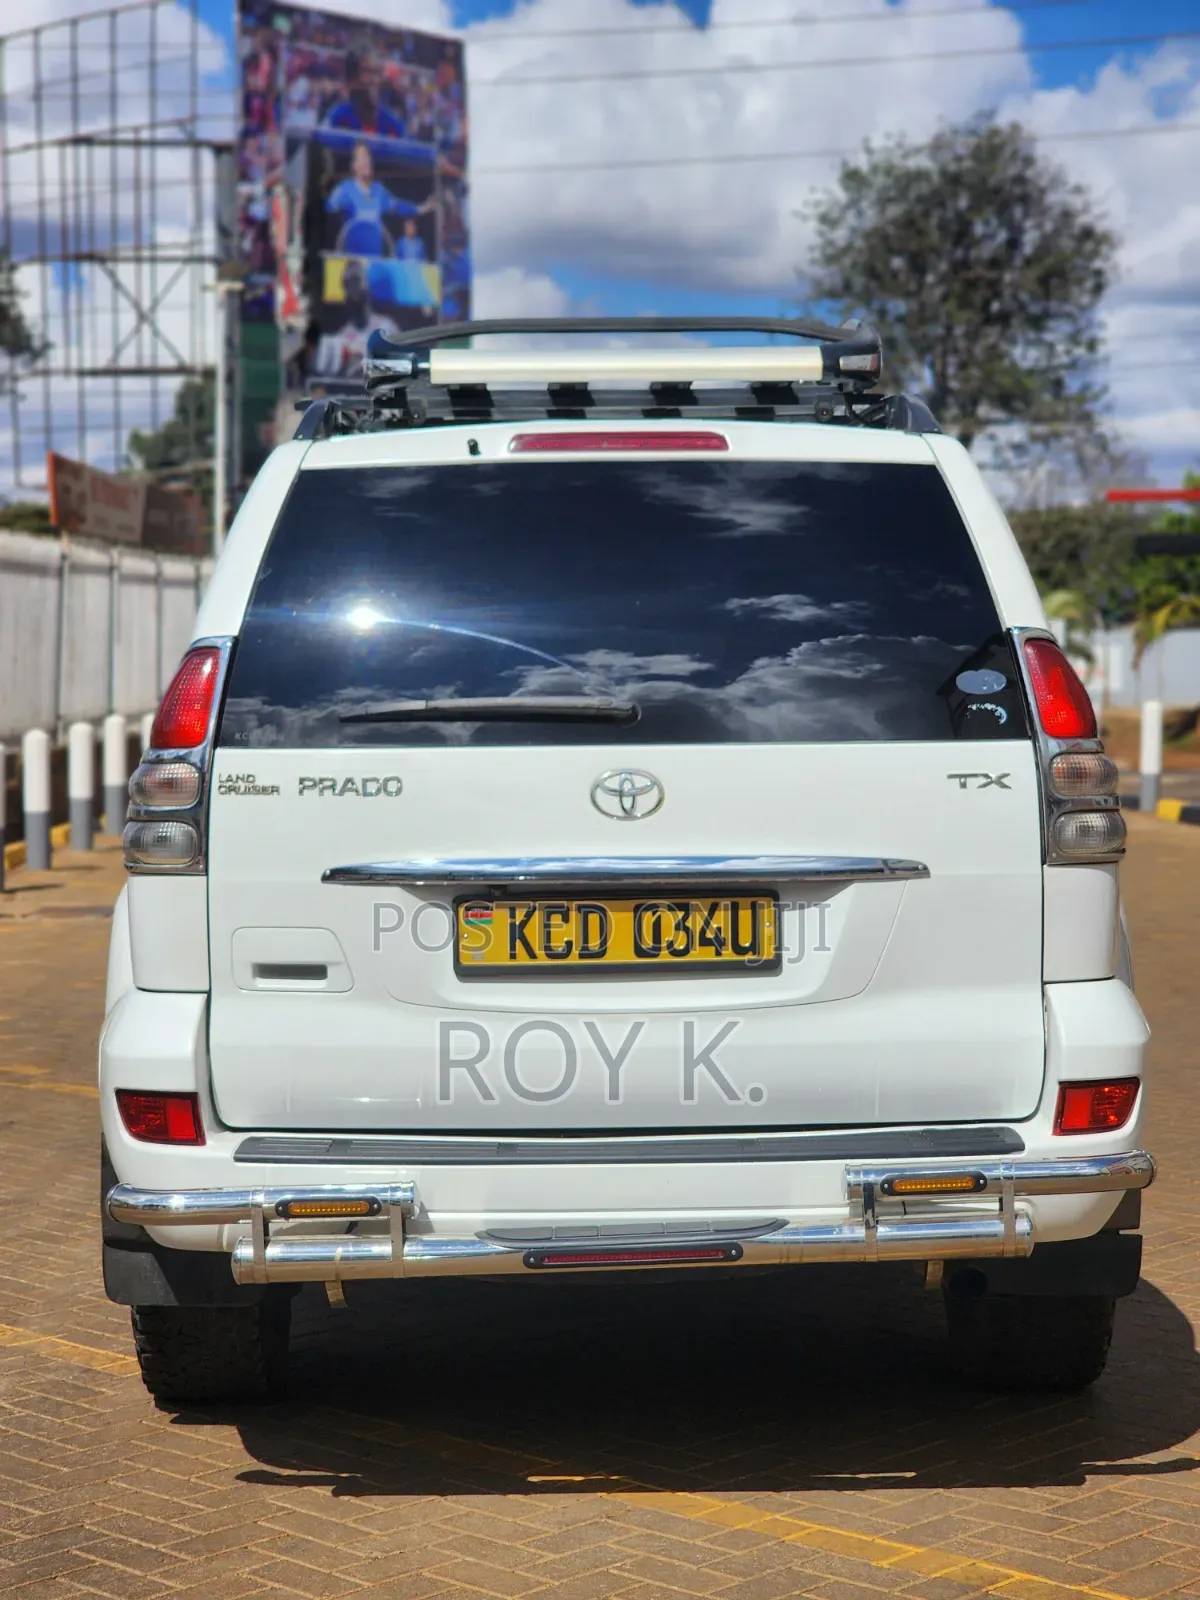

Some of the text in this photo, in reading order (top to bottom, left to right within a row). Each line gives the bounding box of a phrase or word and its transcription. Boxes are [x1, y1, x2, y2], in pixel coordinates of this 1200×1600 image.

[218, 773, 256, 784] LAND
[298, 775, 404, 797] PRADO
[946, 772, 1012, 790] TX
[217, 784, 281, 796] CRUISER
[508, 900, 760, 960] KCD 034U
